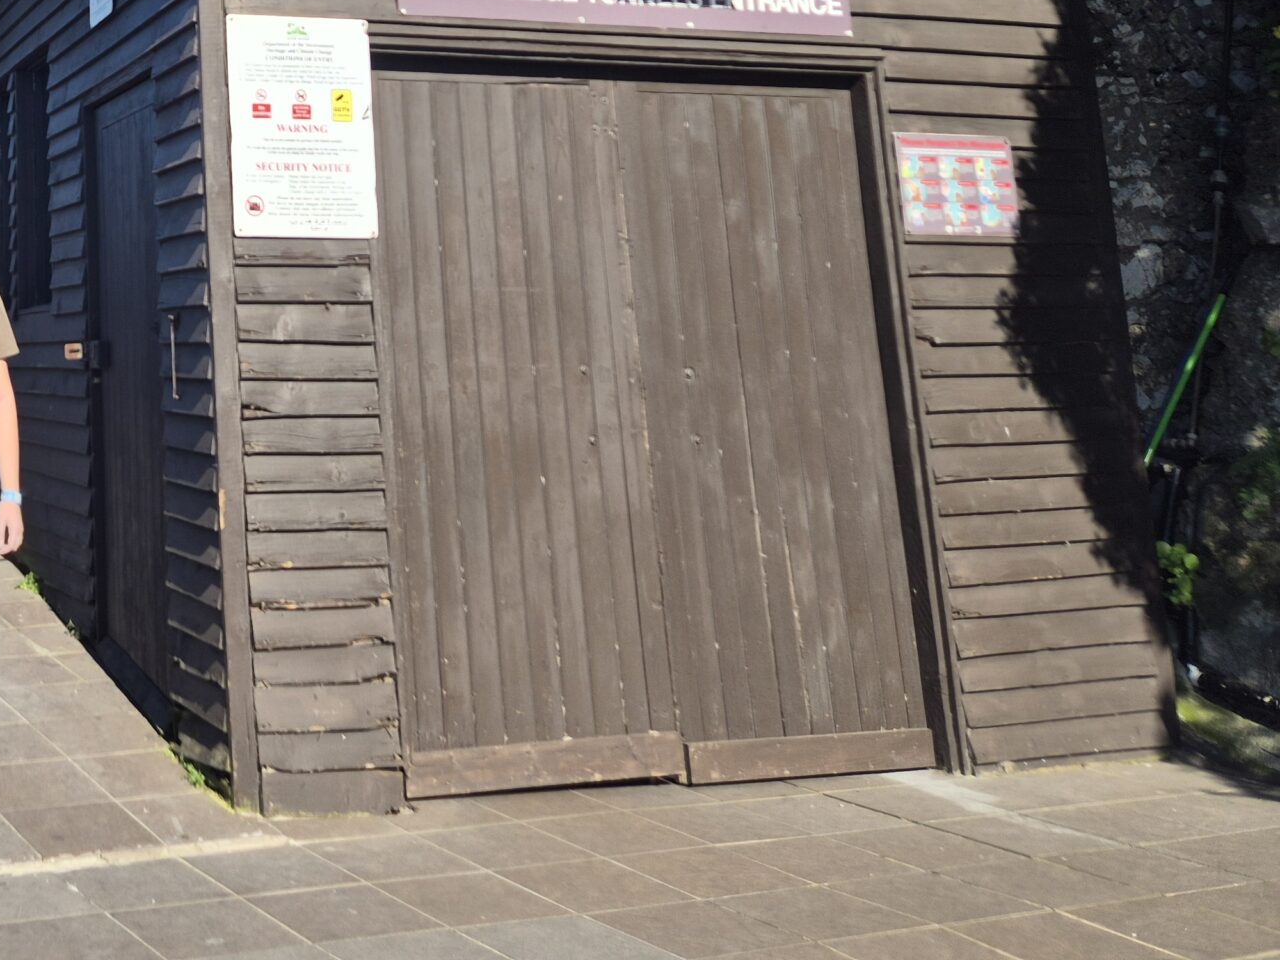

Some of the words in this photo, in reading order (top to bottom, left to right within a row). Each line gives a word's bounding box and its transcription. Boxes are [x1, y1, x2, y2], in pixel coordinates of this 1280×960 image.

[276, 124, 328, 134] WARNING
[255, 162, 308, 172] SECURITY
[312, 163, 351, 173] NOTICE
